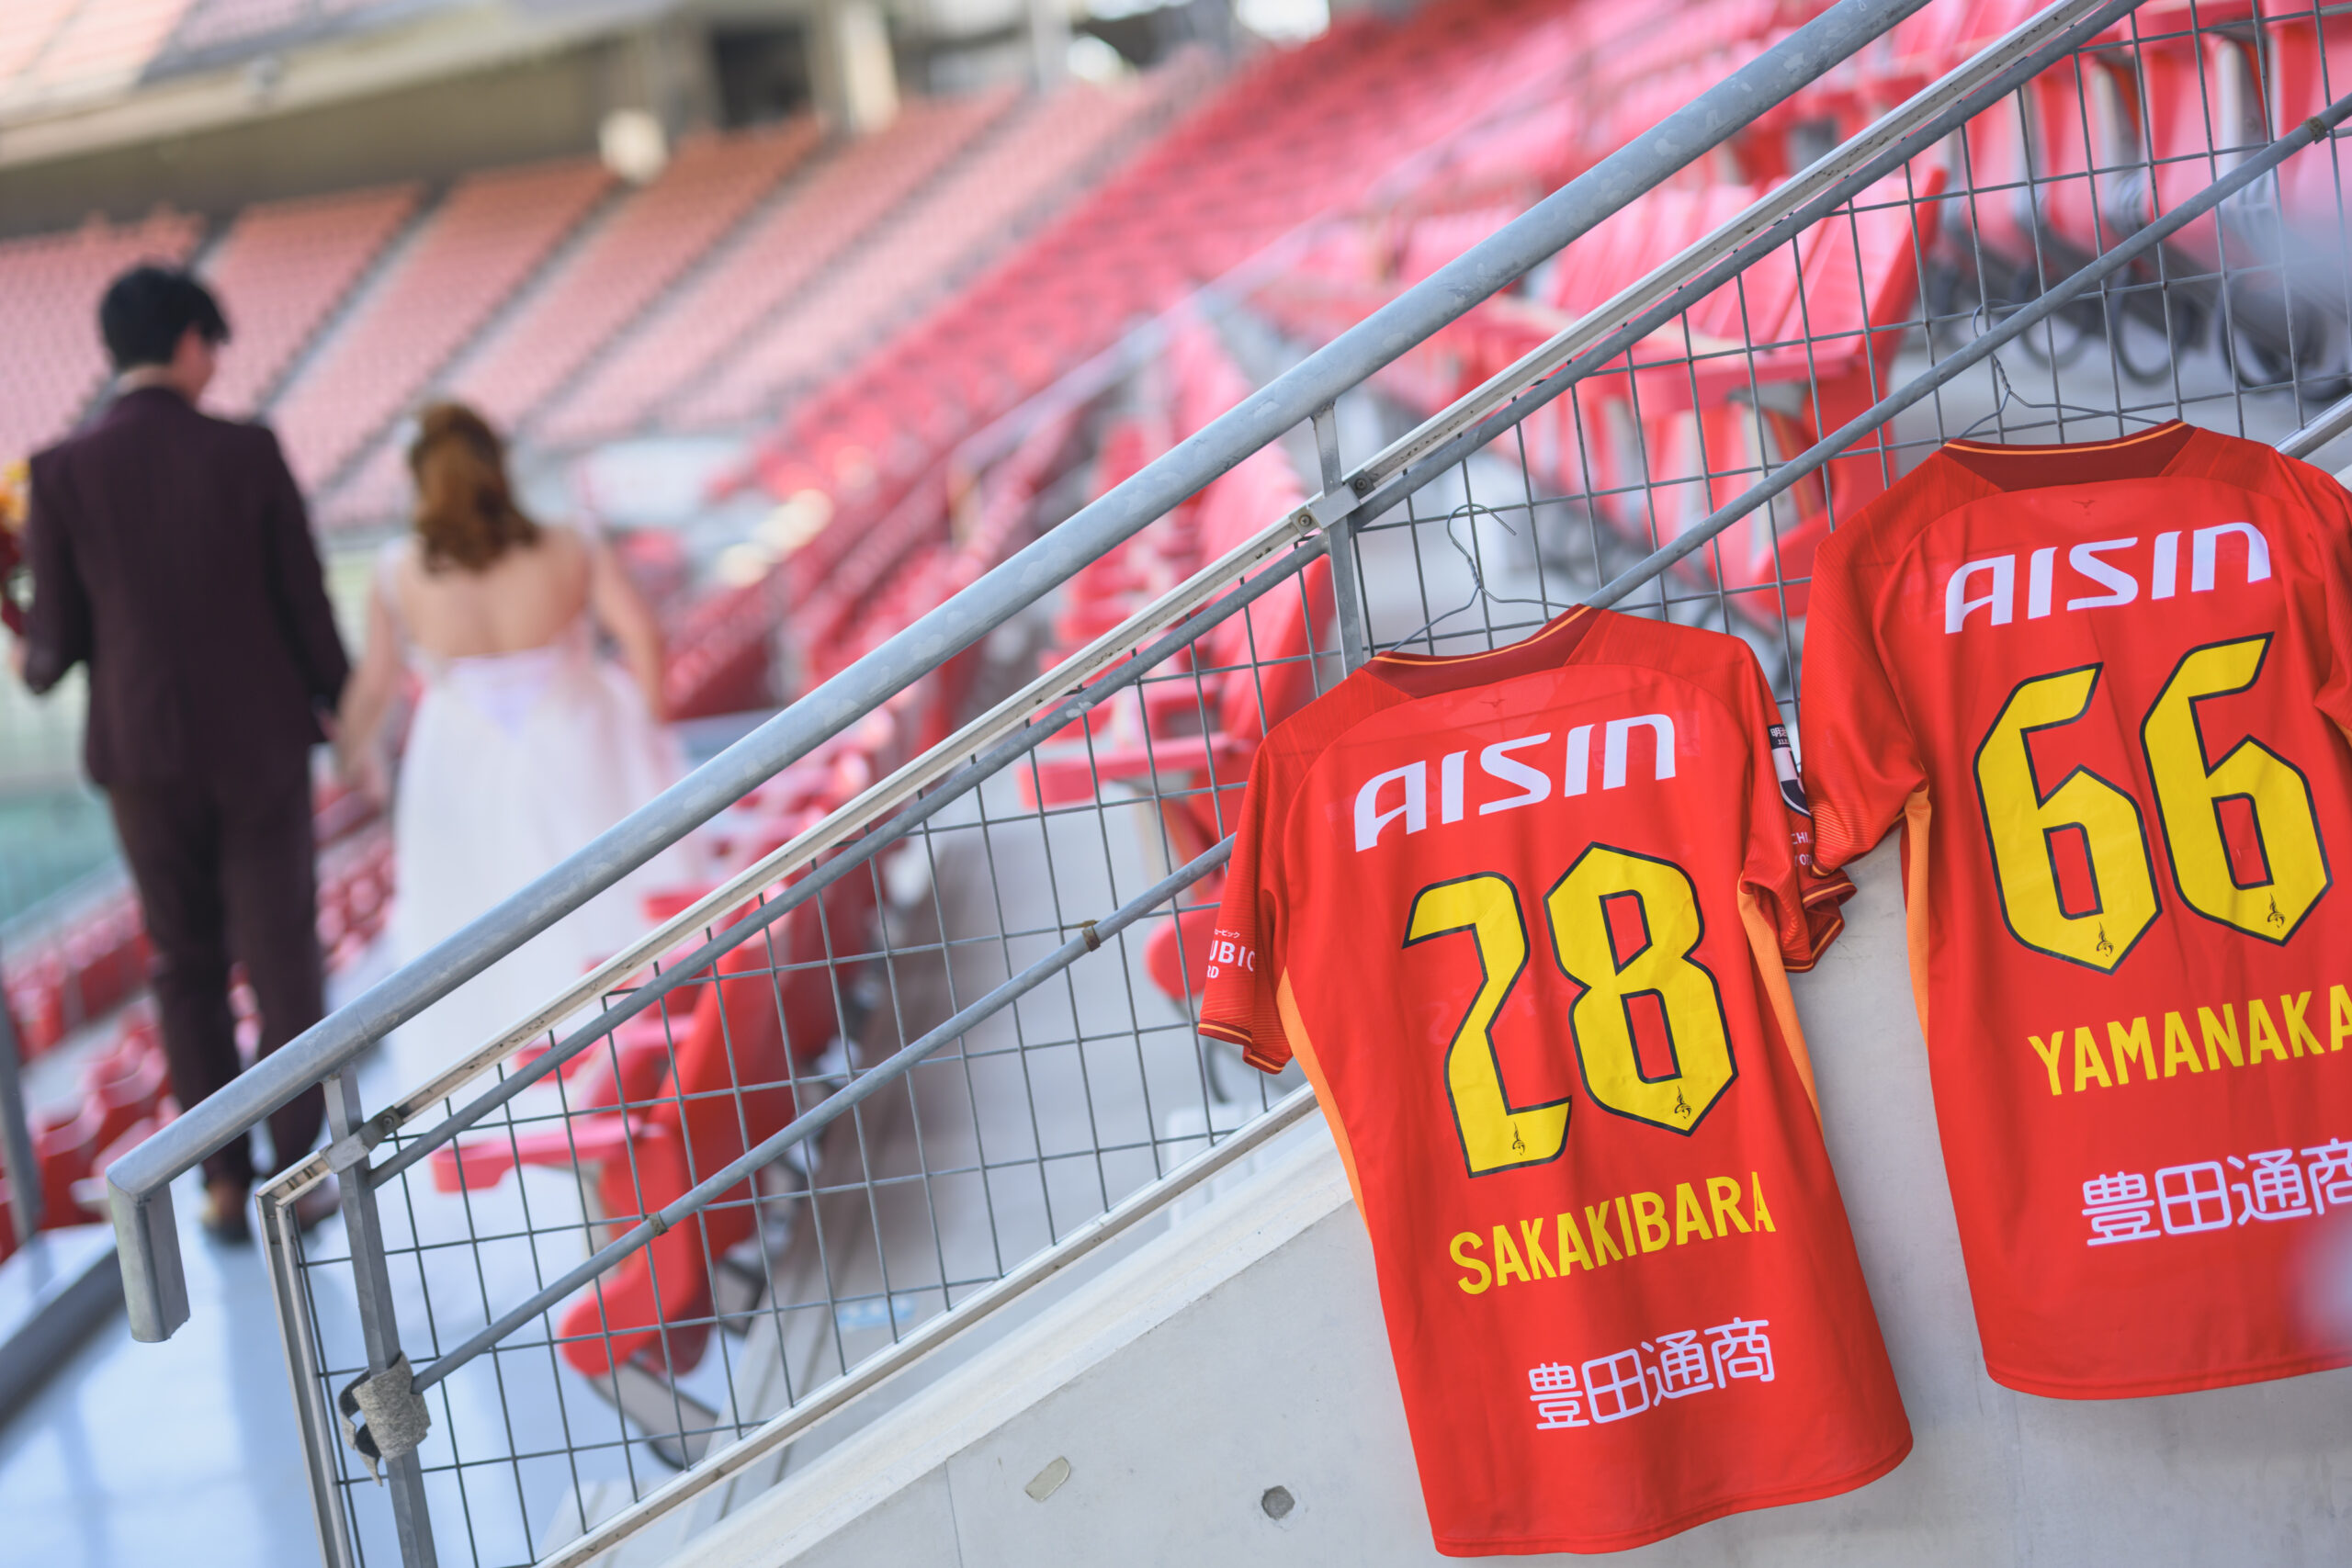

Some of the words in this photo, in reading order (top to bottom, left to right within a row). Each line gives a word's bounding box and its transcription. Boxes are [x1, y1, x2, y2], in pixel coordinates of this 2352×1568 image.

[1943, 522, 2272, 636] AISIN
[1353, 712, 1677, 853] AISIN
[1972, 630, 2334, 976] 66
[1402, 840, 1739, 1179] 28
[1449, 1170, 1777, 1295] SAKAKIBARA
[2081, 1137, 2352, 1247] 豊田通商
[1528, 1316, 1775, 1430] 豊田通商
